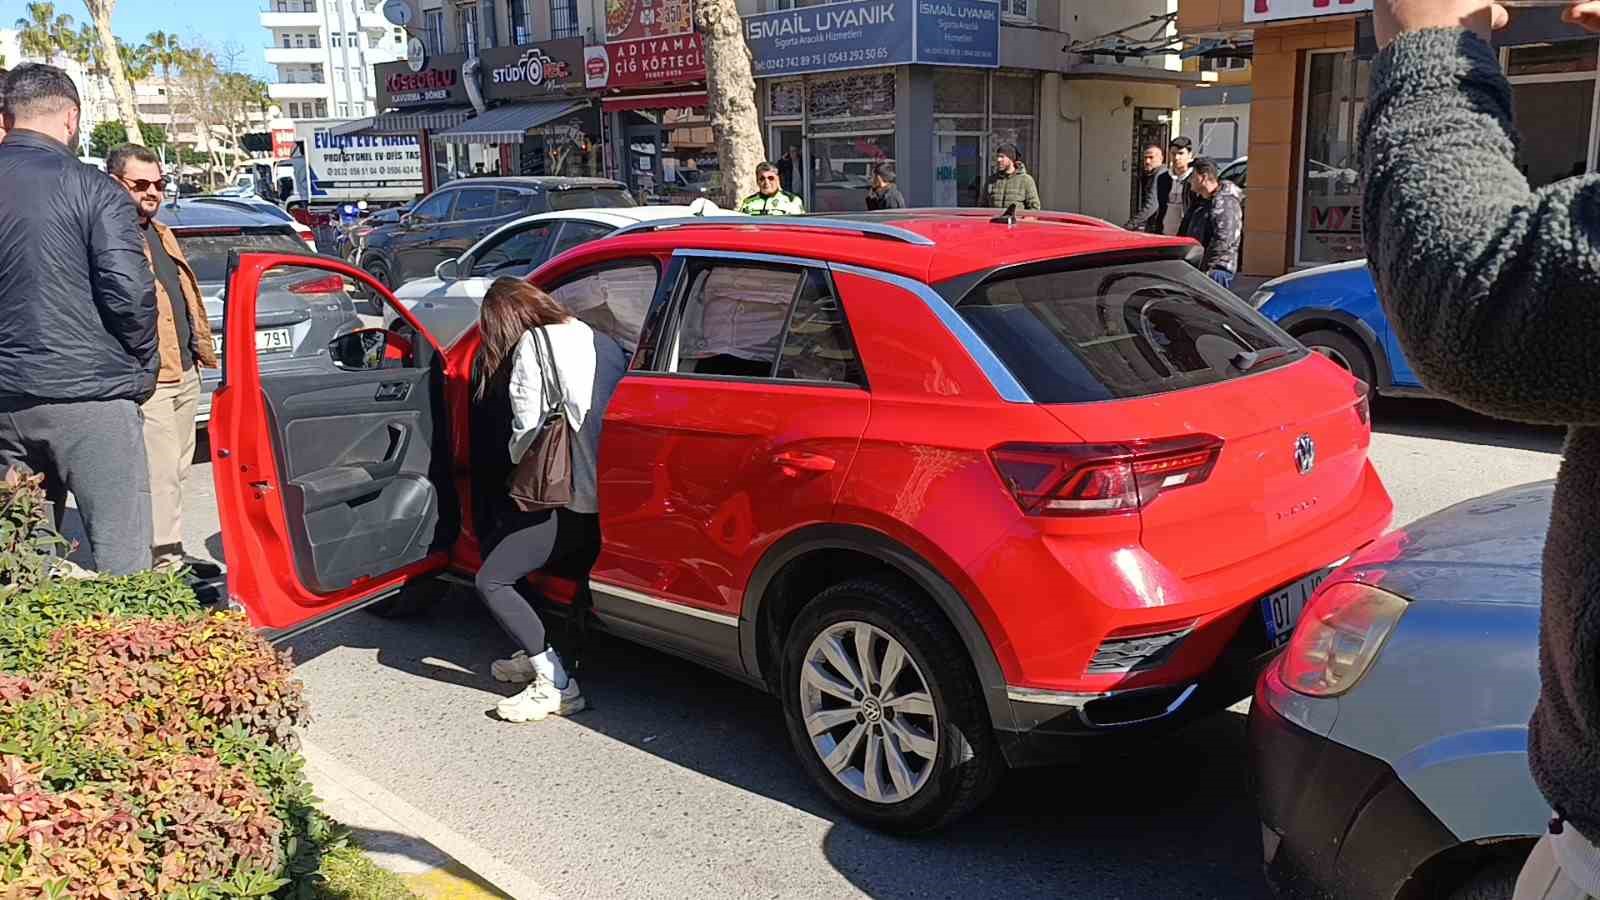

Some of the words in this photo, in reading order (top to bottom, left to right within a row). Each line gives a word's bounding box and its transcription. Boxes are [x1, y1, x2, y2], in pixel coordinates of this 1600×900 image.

[745, 12, 811, 39] İSMAİL
[816, 3, 896, 31] UYANIK
[785, 56, 799, 67] 742
[812, 54, 821, 65] 75
[828, 50, 848, 64] 0543
[849, 49, 864, 61] 292
[865, 48, 876, 60] 50
[877, 47, 888, 59] 65
[615, 59, 637, 77] ÇİĞ
[264, 331, 288, 346] 791
[1273, 592, 1290, 628] 07
